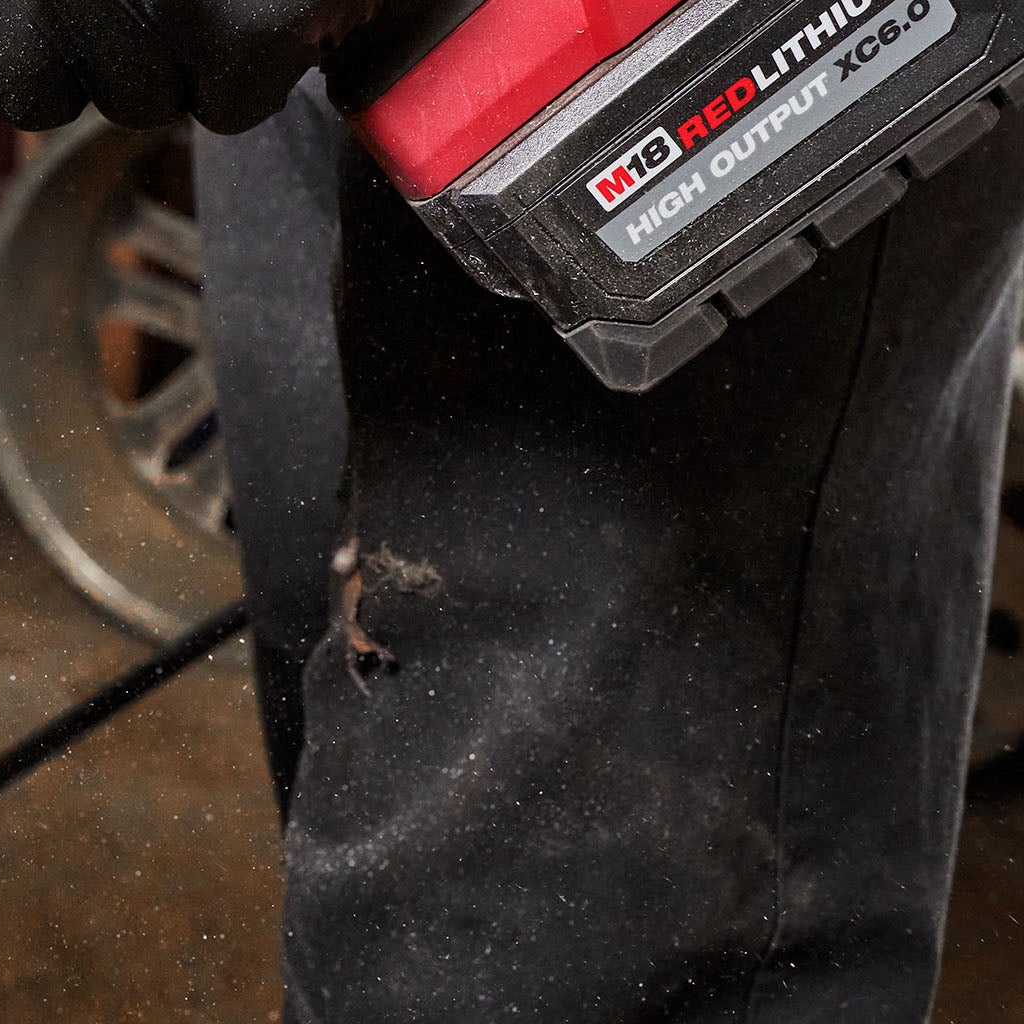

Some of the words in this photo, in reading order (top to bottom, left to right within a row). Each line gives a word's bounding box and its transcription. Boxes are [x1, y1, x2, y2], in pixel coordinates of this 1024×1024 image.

[595, 136, 671, 204] M18
[627, 172, 706, 246] HIGH
[710, 71, 830, 176] OUTPUT
